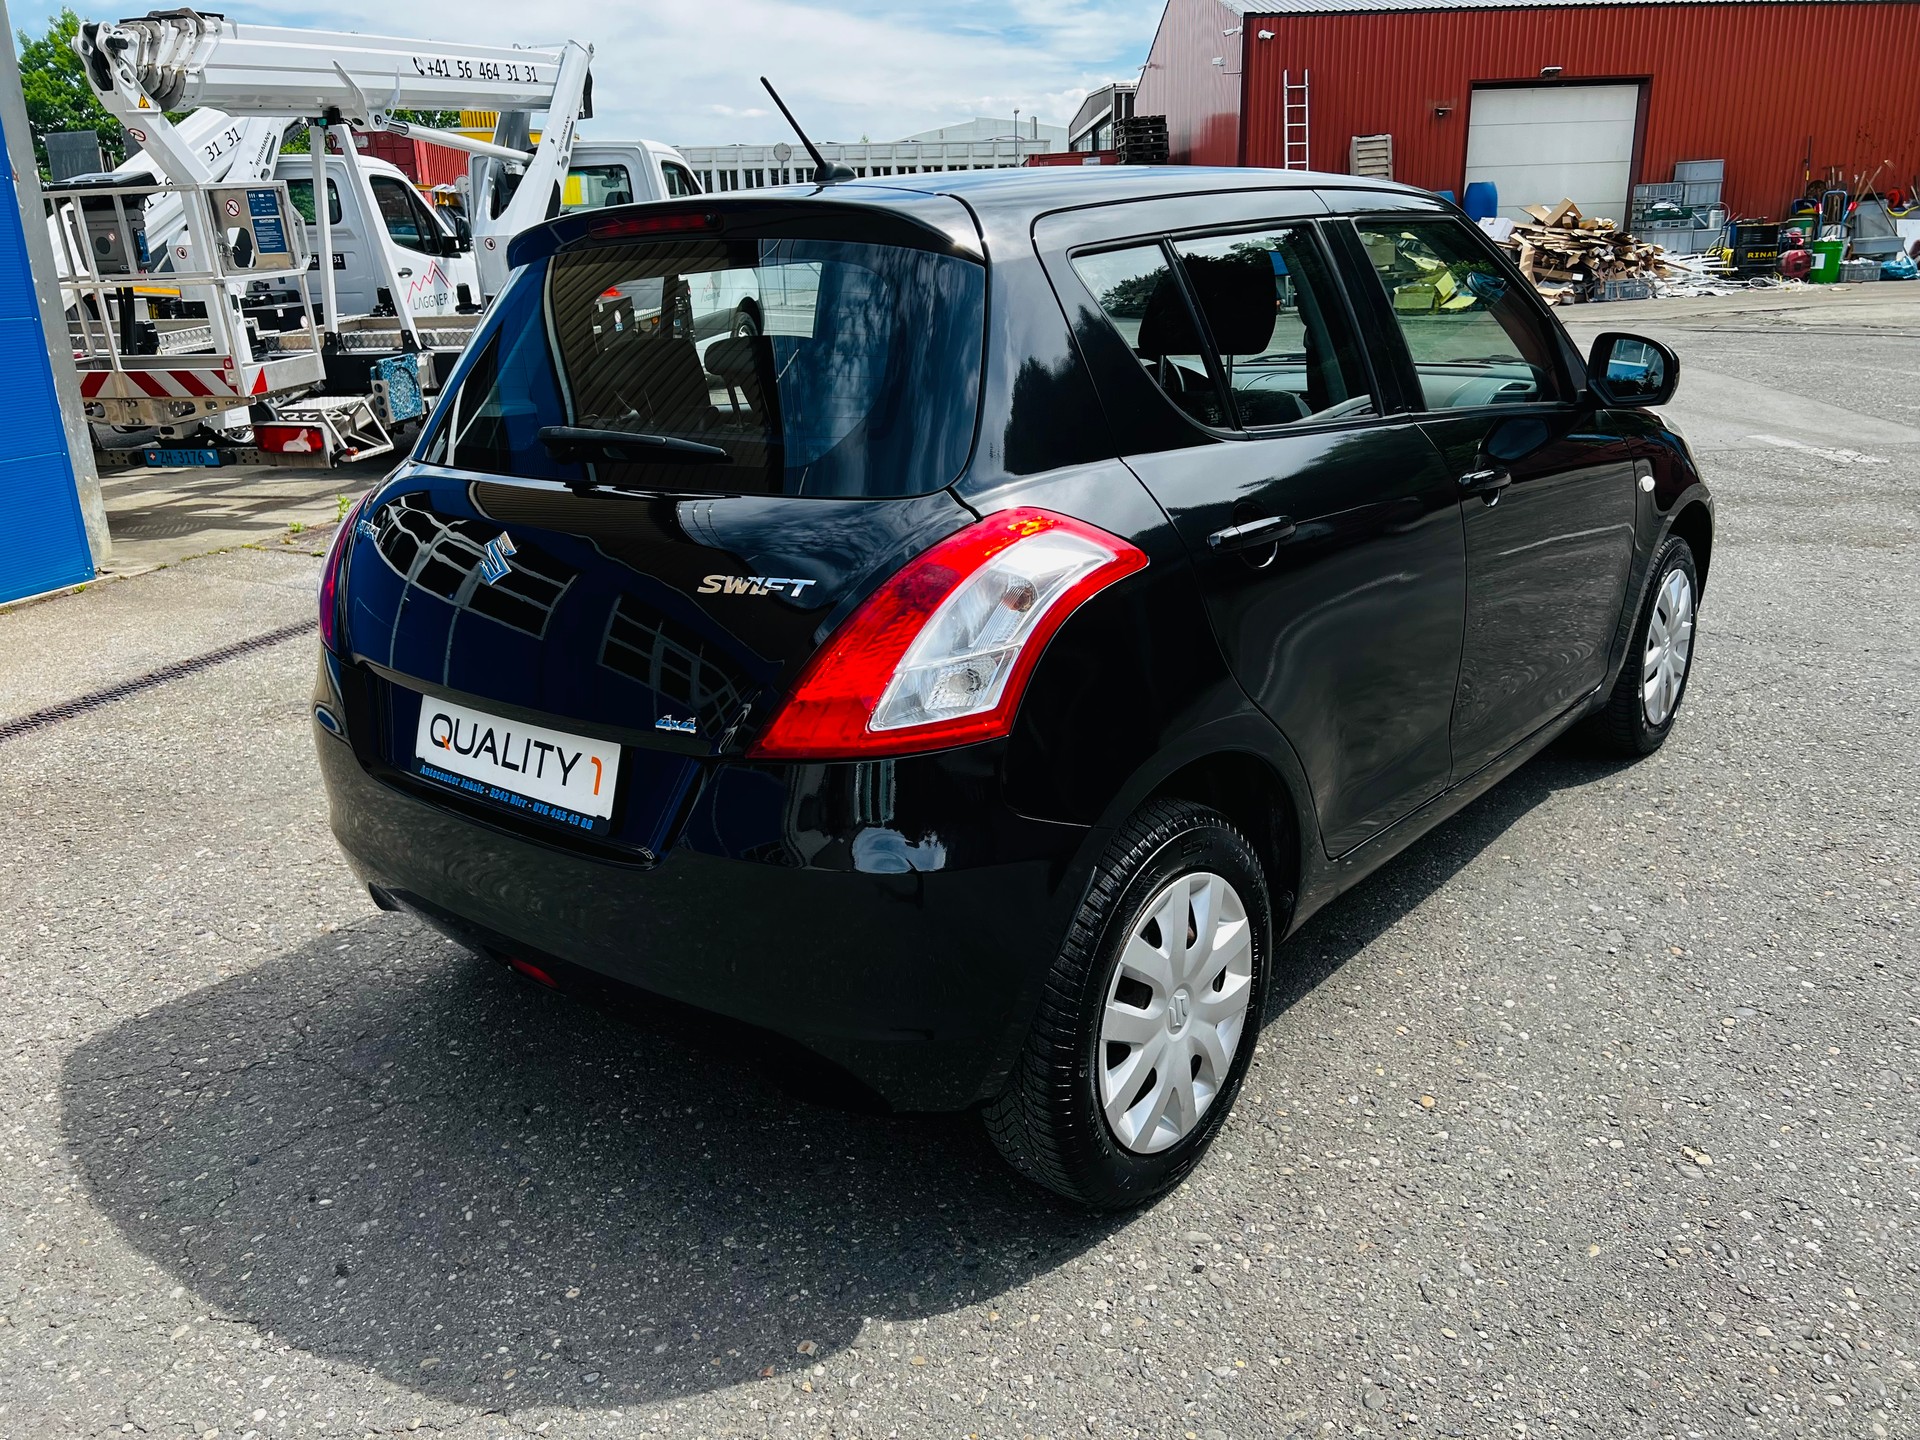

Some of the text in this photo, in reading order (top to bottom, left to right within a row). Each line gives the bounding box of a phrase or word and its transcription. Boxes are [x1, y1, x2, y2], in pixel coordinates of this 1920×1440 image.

[428, 59, 539, 83] +41 56 464 31 31
[204, 141, 223, 162] 31
[224, 126, 242, 147] 31
[254, 130, 272, 167] RUTHMANN
[413, 292, 450, 311] LAGGNER
[696, 574, 817, 598] SWIFT
[429, 712, 603, 796] QUALITY 1
[419, 764, 461, 786] Autocenter
[489, 787, 509, 803] 5242
[509, 794, 528, 809] Birr
[532, 802, 550, 816] 076
[549, 808, 568, 822] 455
[568, 814, 581, 826] 43
